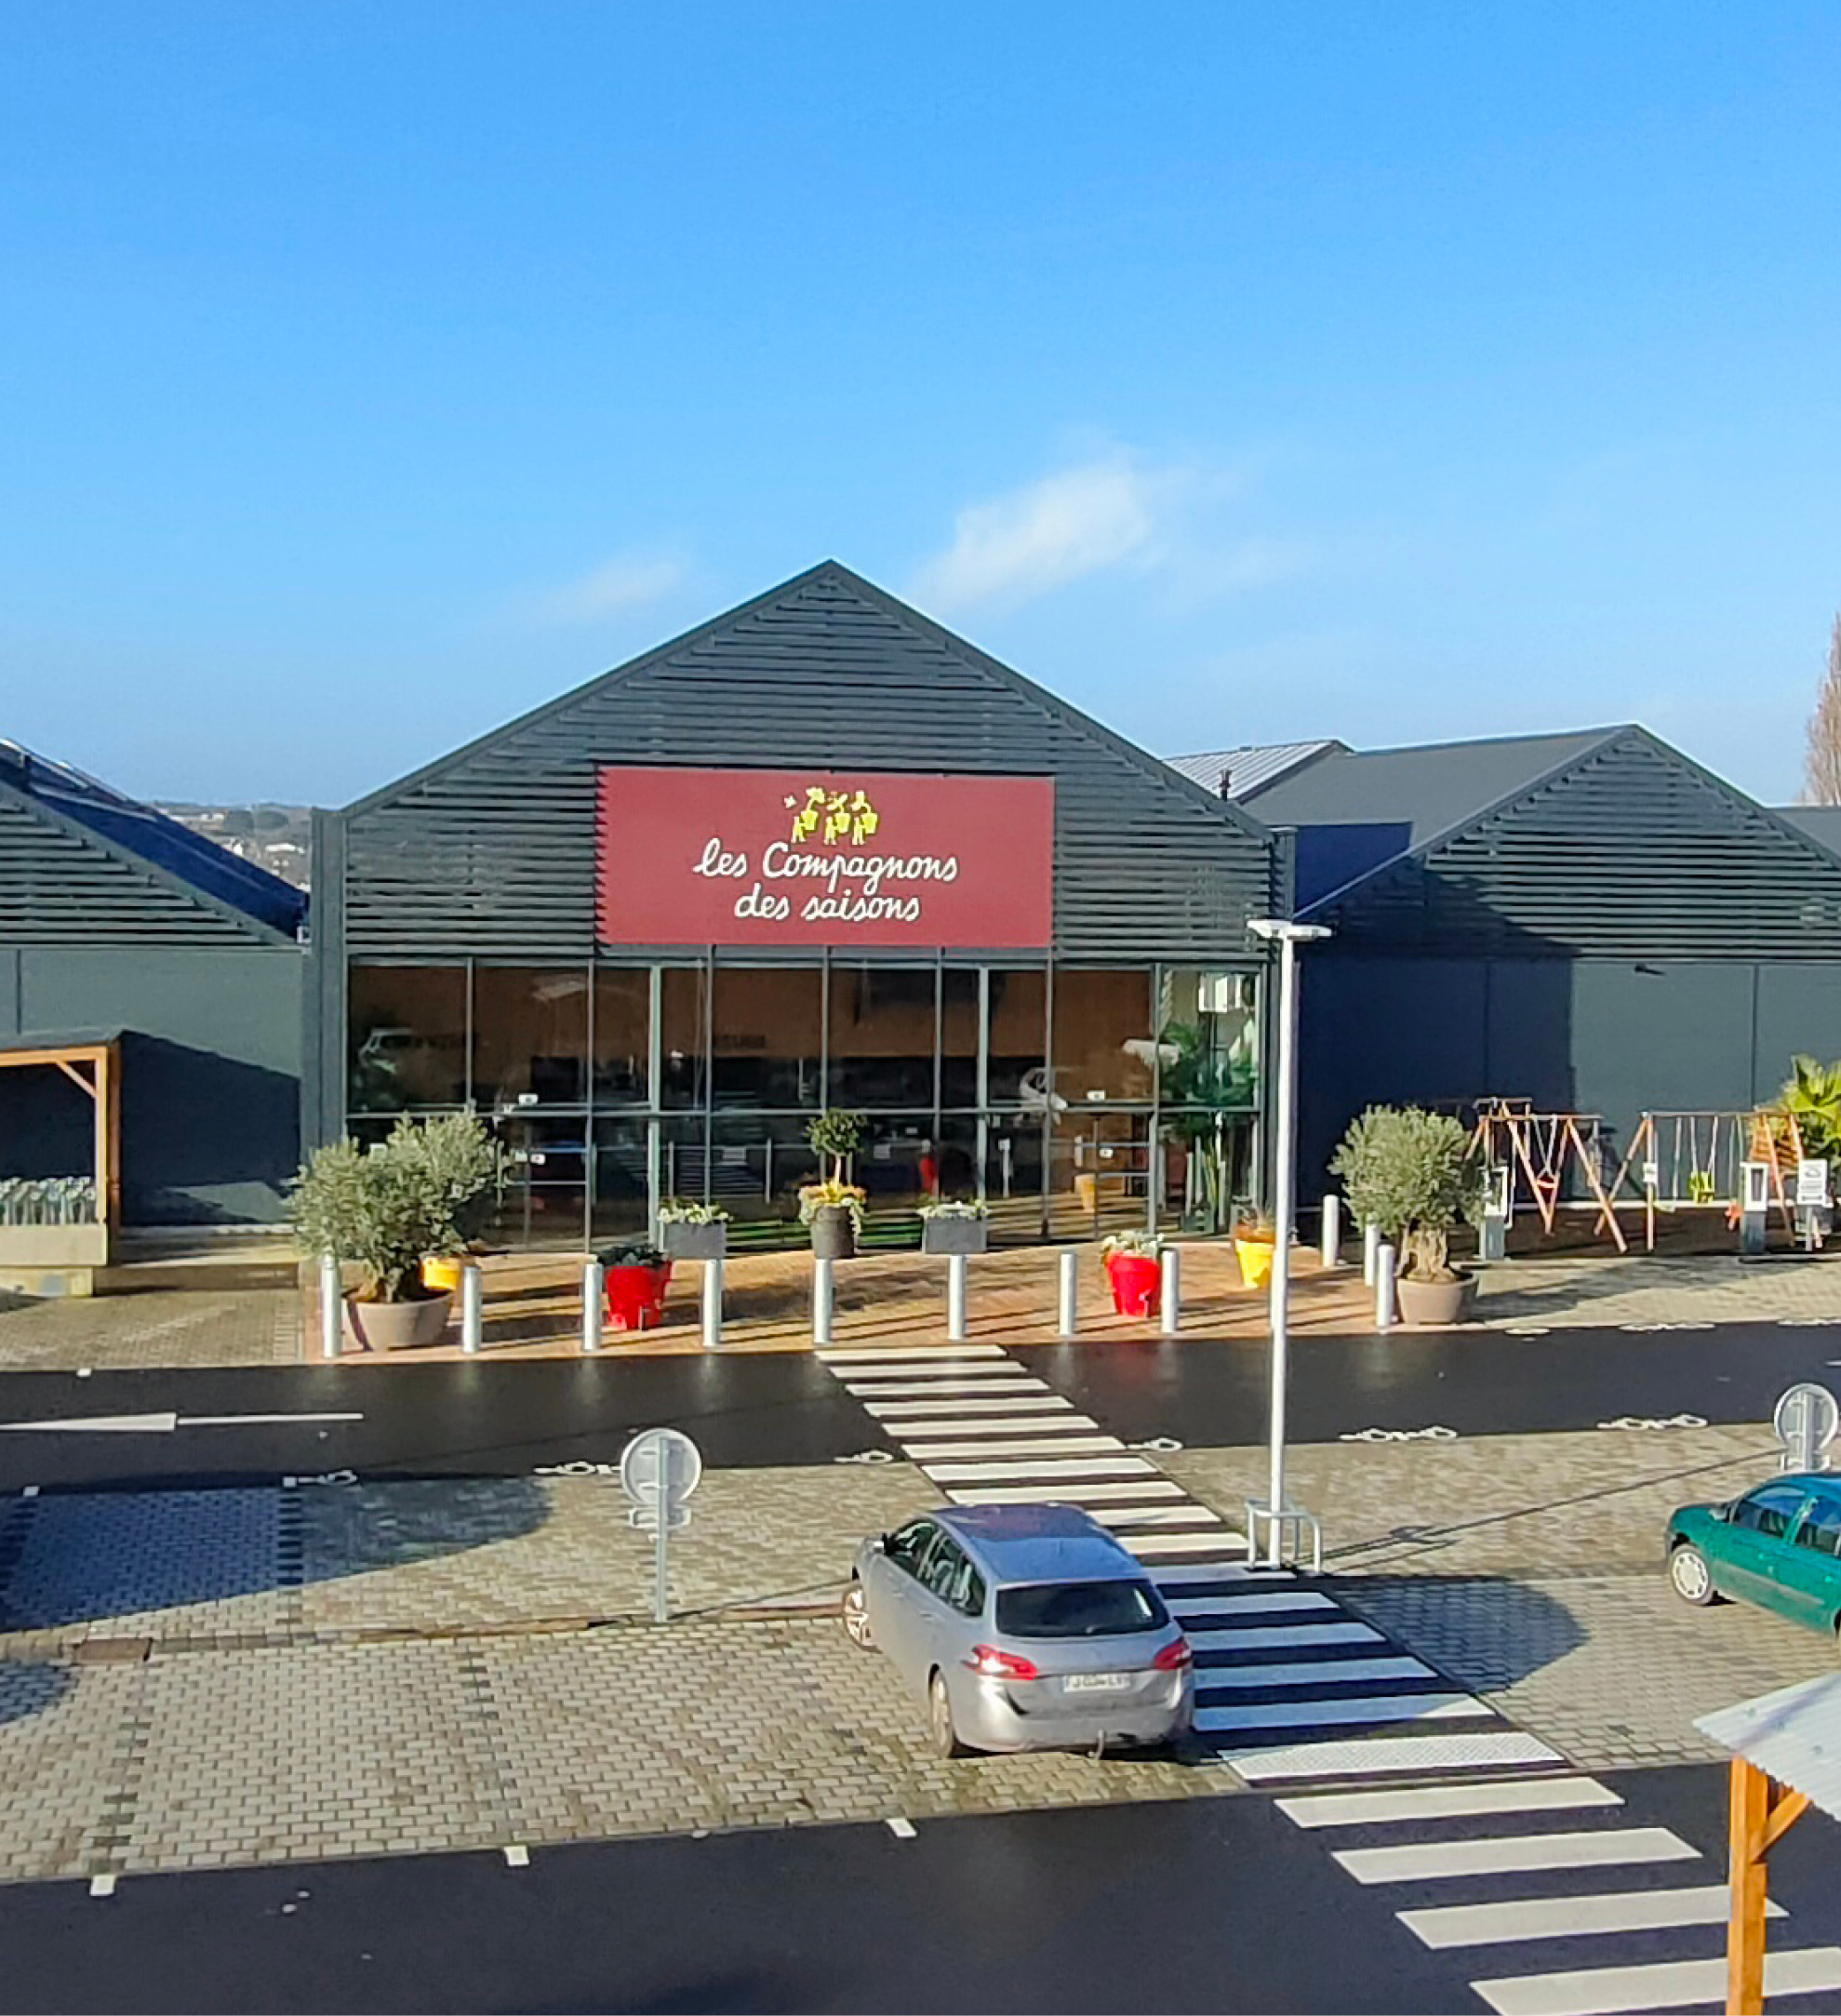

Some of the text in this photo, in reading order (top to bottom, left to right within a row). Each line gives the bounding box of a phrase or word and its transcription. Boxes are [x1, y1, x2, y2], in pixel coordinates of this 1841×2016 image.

[692, 838, 957, 896] les Compagnons
[734, 883, 919, 921] des saisons
